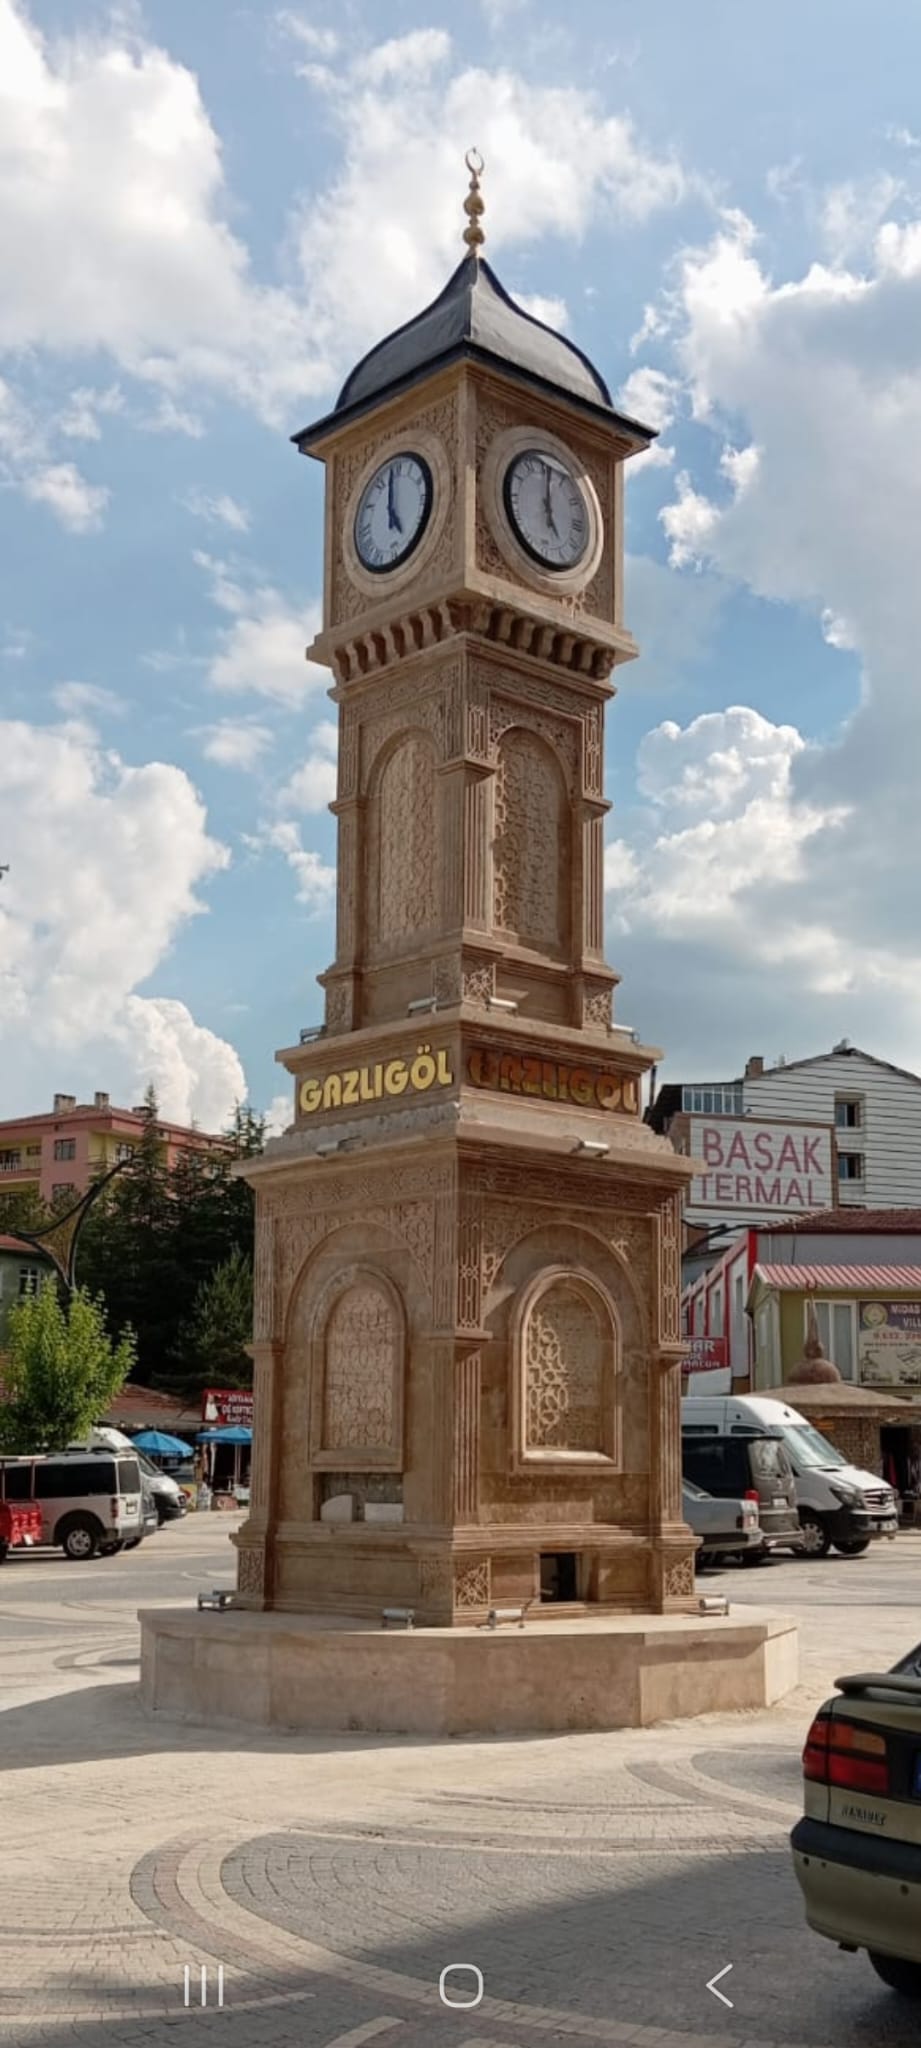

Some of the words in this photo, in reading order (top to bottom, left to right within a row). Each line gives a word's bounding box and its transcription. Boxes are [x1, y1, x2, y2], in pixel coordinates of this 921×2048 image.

[299, 1045, 453, 1113] GAZLIGÖL
[701, 1127, 825, 1176] BAŞAK
[697, 1172, 826, 1207] TERMAL
